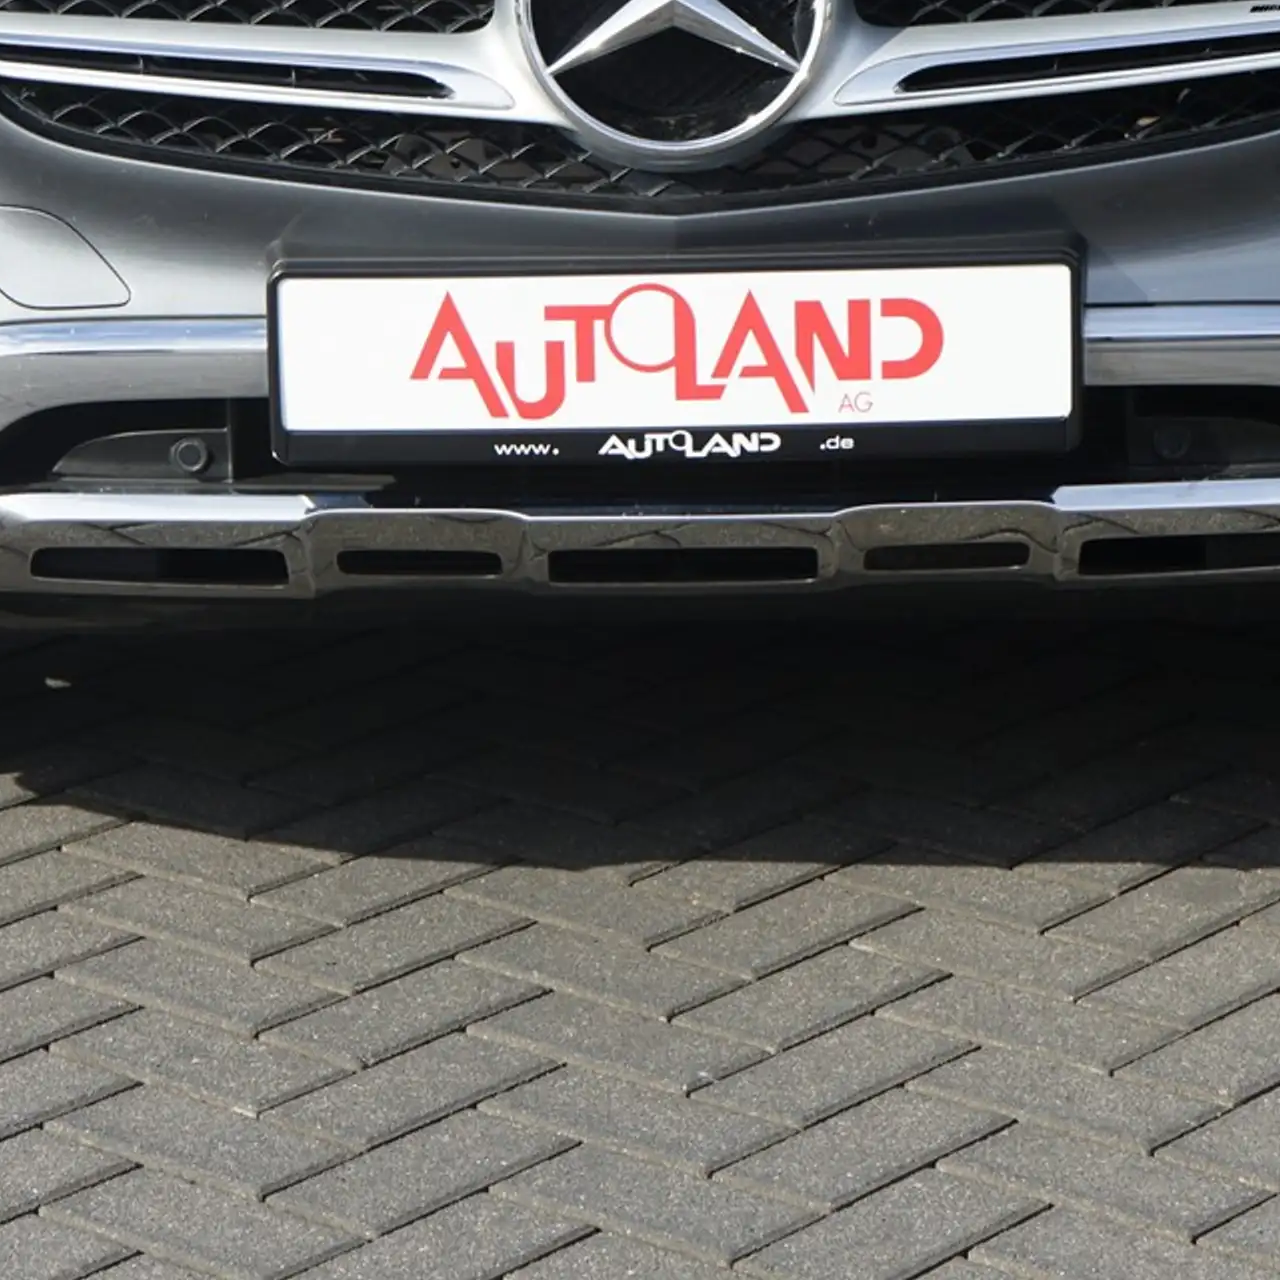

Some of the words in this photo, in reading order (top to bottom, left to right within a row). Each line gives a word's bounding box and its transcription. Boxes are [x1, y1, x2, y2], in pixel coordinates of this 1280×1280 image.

[410, 282, 946, 421] AUTOLAND
[837, 392, 875, 414] AG
[493, 442, 560, 457] www.
[598, 428, 782, 461] AUTOLAND
[819, 434, 856, 451] .de
